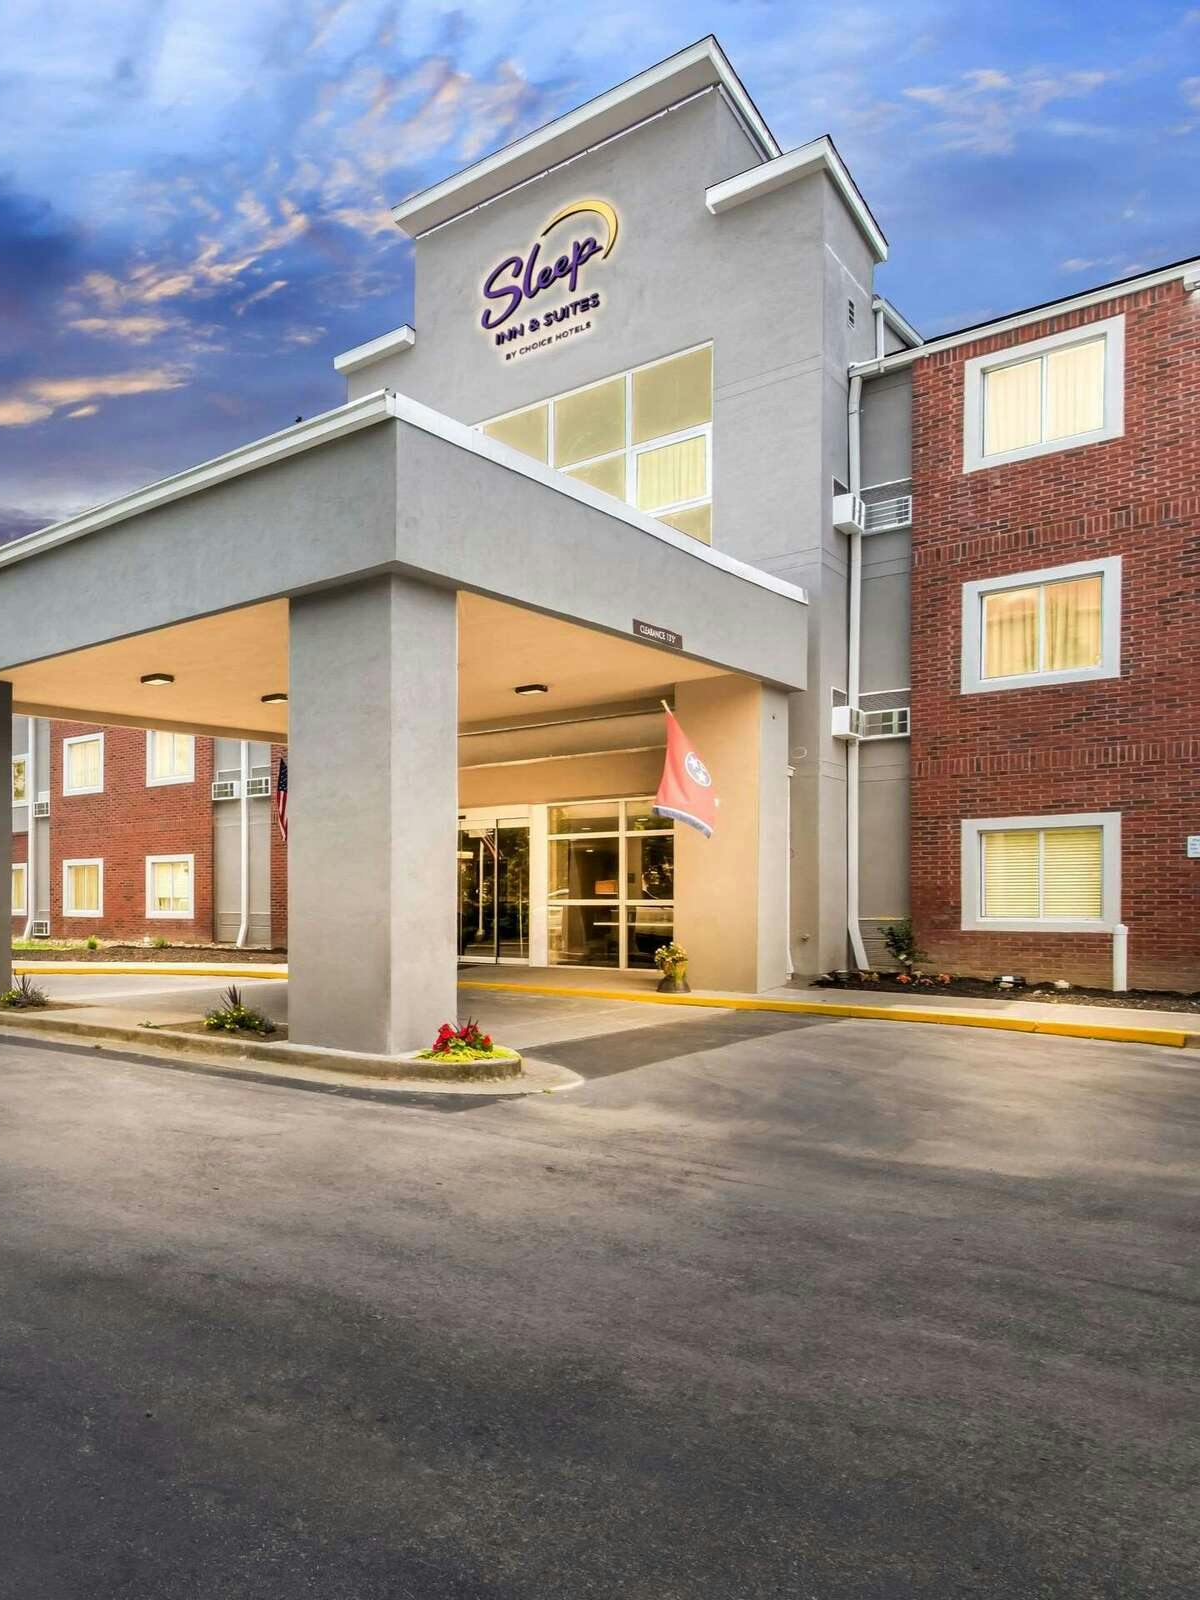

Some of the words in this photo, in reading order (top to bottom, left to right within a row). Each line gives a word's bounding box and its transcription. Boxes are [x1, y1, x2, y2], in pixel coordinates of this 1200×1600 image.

[481, 237, 604, 330] Sleep
[495, 323, 525, 346] INN
[528, 318, 540, 332] &
[543, 293, 600, 327] SUITES
[505, 350, 517, 361] BY
[519, 336, 553, 355] CHOICE
[555, 321, 591, 341] HOTELS
